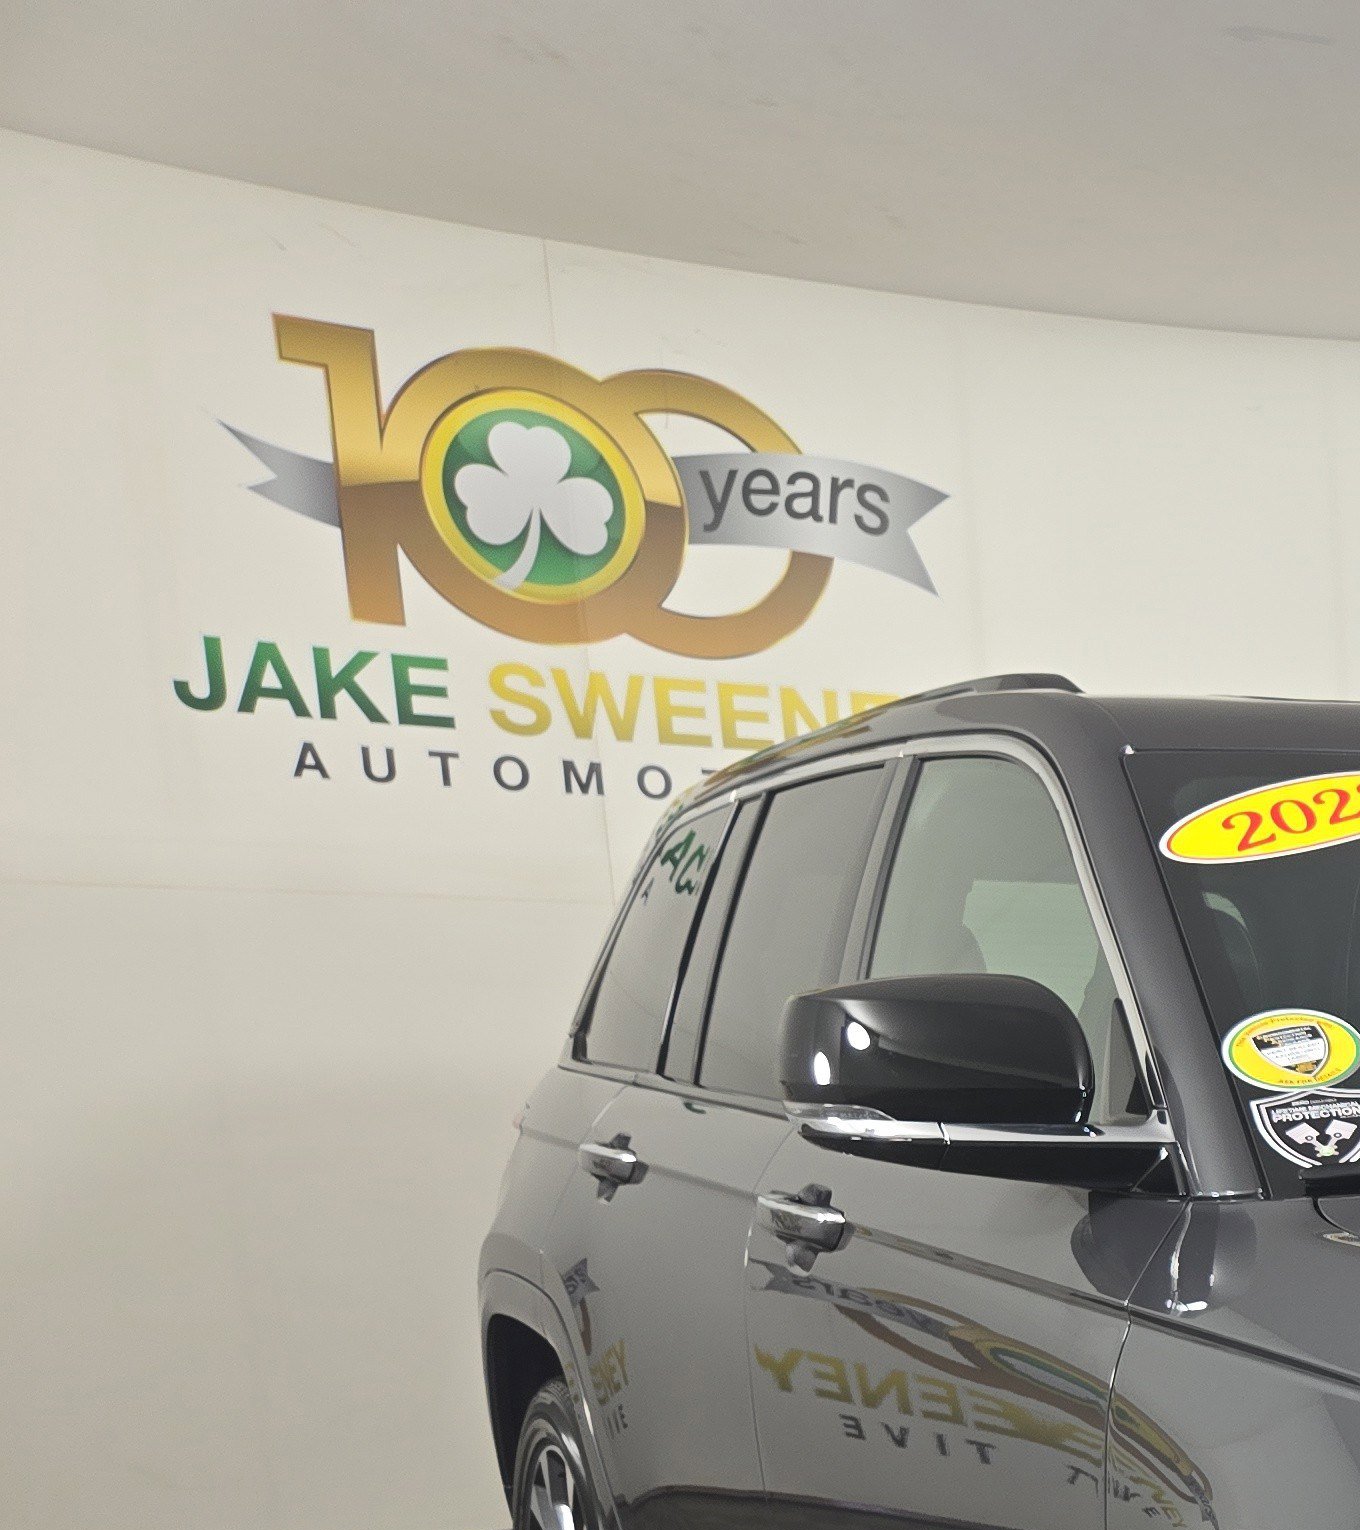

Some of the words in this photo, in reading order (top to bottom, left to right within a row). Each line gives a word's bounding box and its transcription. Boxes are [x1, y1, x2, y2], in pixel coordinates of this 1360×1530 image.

[700, 467, 892, 536] years
[172, 634, 456, 730] JAKE
[488, 661, 900, 751] SWEEN
